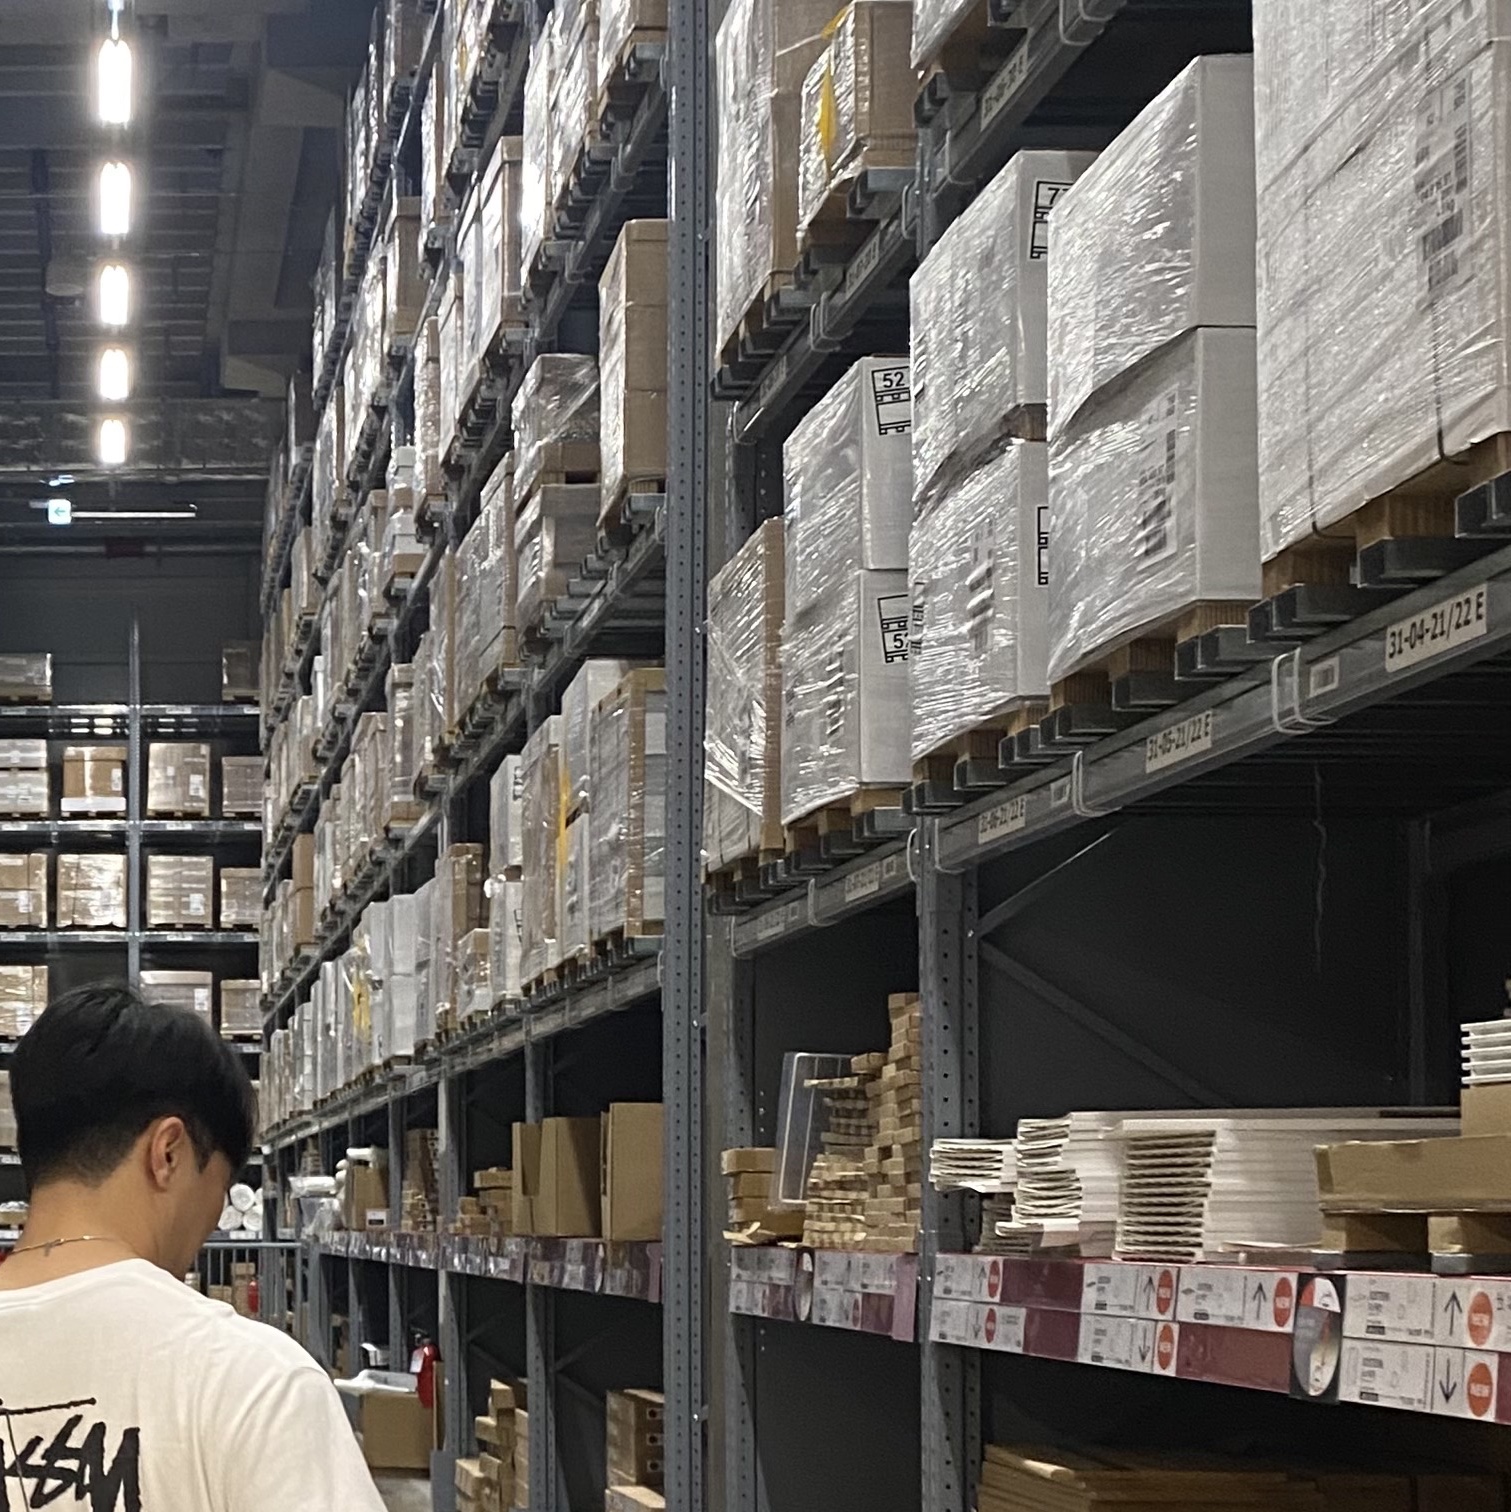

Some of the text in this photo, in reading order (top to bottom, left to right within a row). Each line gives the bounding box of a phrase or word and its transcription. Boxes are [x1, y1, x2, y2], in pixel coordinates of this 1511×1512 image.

[1047, 186, 1071, 206] 7
[882, 371, 906, 389] 52
[1388, 591, 1484, 659] 31-04-21/22 E
[893, 632, 909, 650] 5
